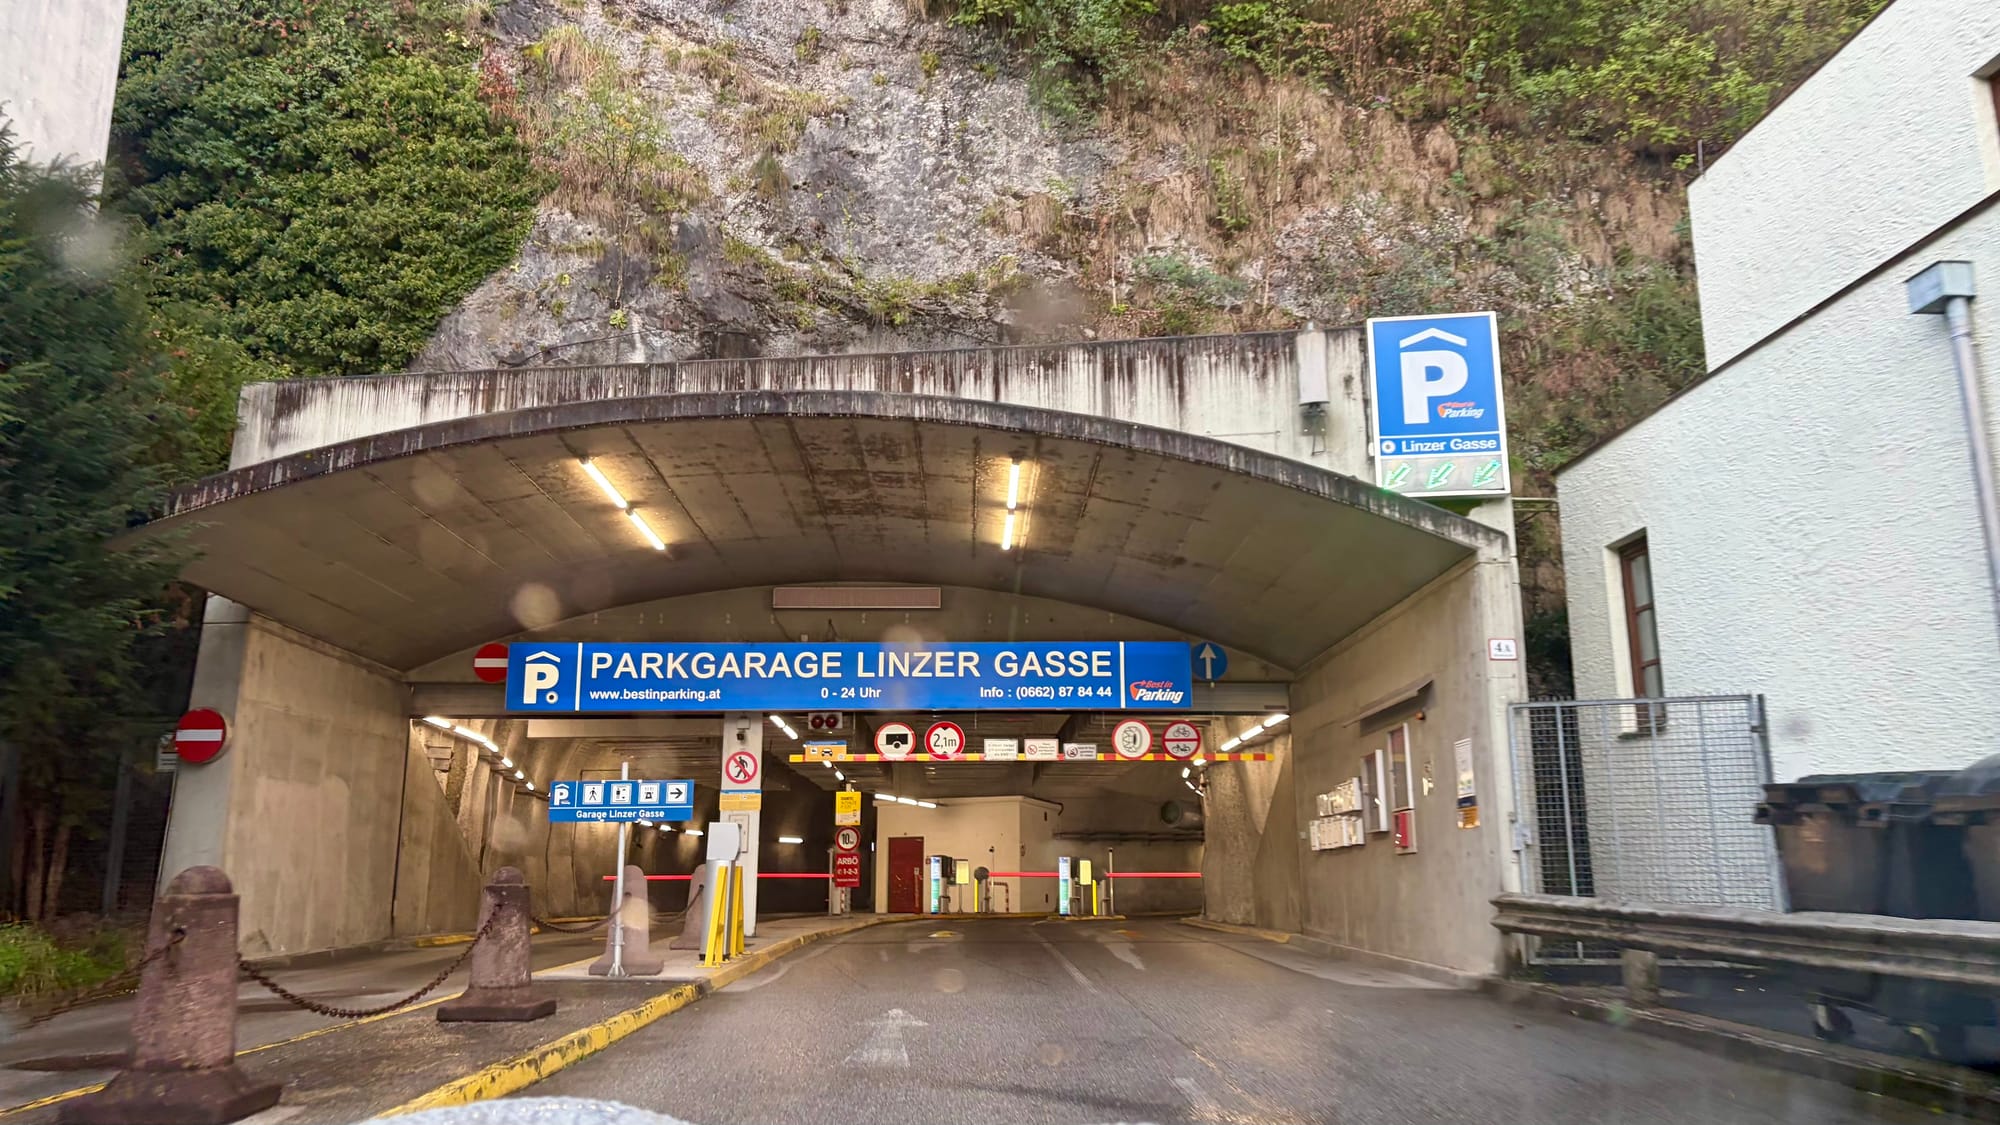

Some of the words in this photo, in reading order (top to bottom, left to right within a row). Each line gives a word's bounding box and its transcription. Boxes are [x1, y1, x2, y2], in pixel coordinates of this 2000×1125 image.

[1400, 350, 1468, 425] P
[1402, 441, 1446, 452] Linzer
[1450, 438, 1497, 450] Gasse
[591, 652, 842, 679] PARKGARAGE
[857, 651, 980, 678] LINZER
[994, 650, 1112, 677] GASSE
[523, 663, 558, 704] P
[590, 688, 721, 702] www.bestinparking.at
[821, 687, 828, 698] 0
[841, 687, 855, 698] 24
[859, 687, 882, 698] Uhr
[980, 686, 1004, 698] Info
[1015, 686, 1055, 700] (0662)
[1058, 686, 1075, 698] 87
[1077, 686, 1093, 698] 84
[1096, 686, 1112, 698] 44
[1135, 688, 1184, 704] Parking
[933, 733, 957, 748] 2,1m
[576, 810, 607, 819] Garage
[609, 809, 637, 818] Linzer
[639, 809, 665, 818] Gasse
[841, 832, 850, 845] 10
